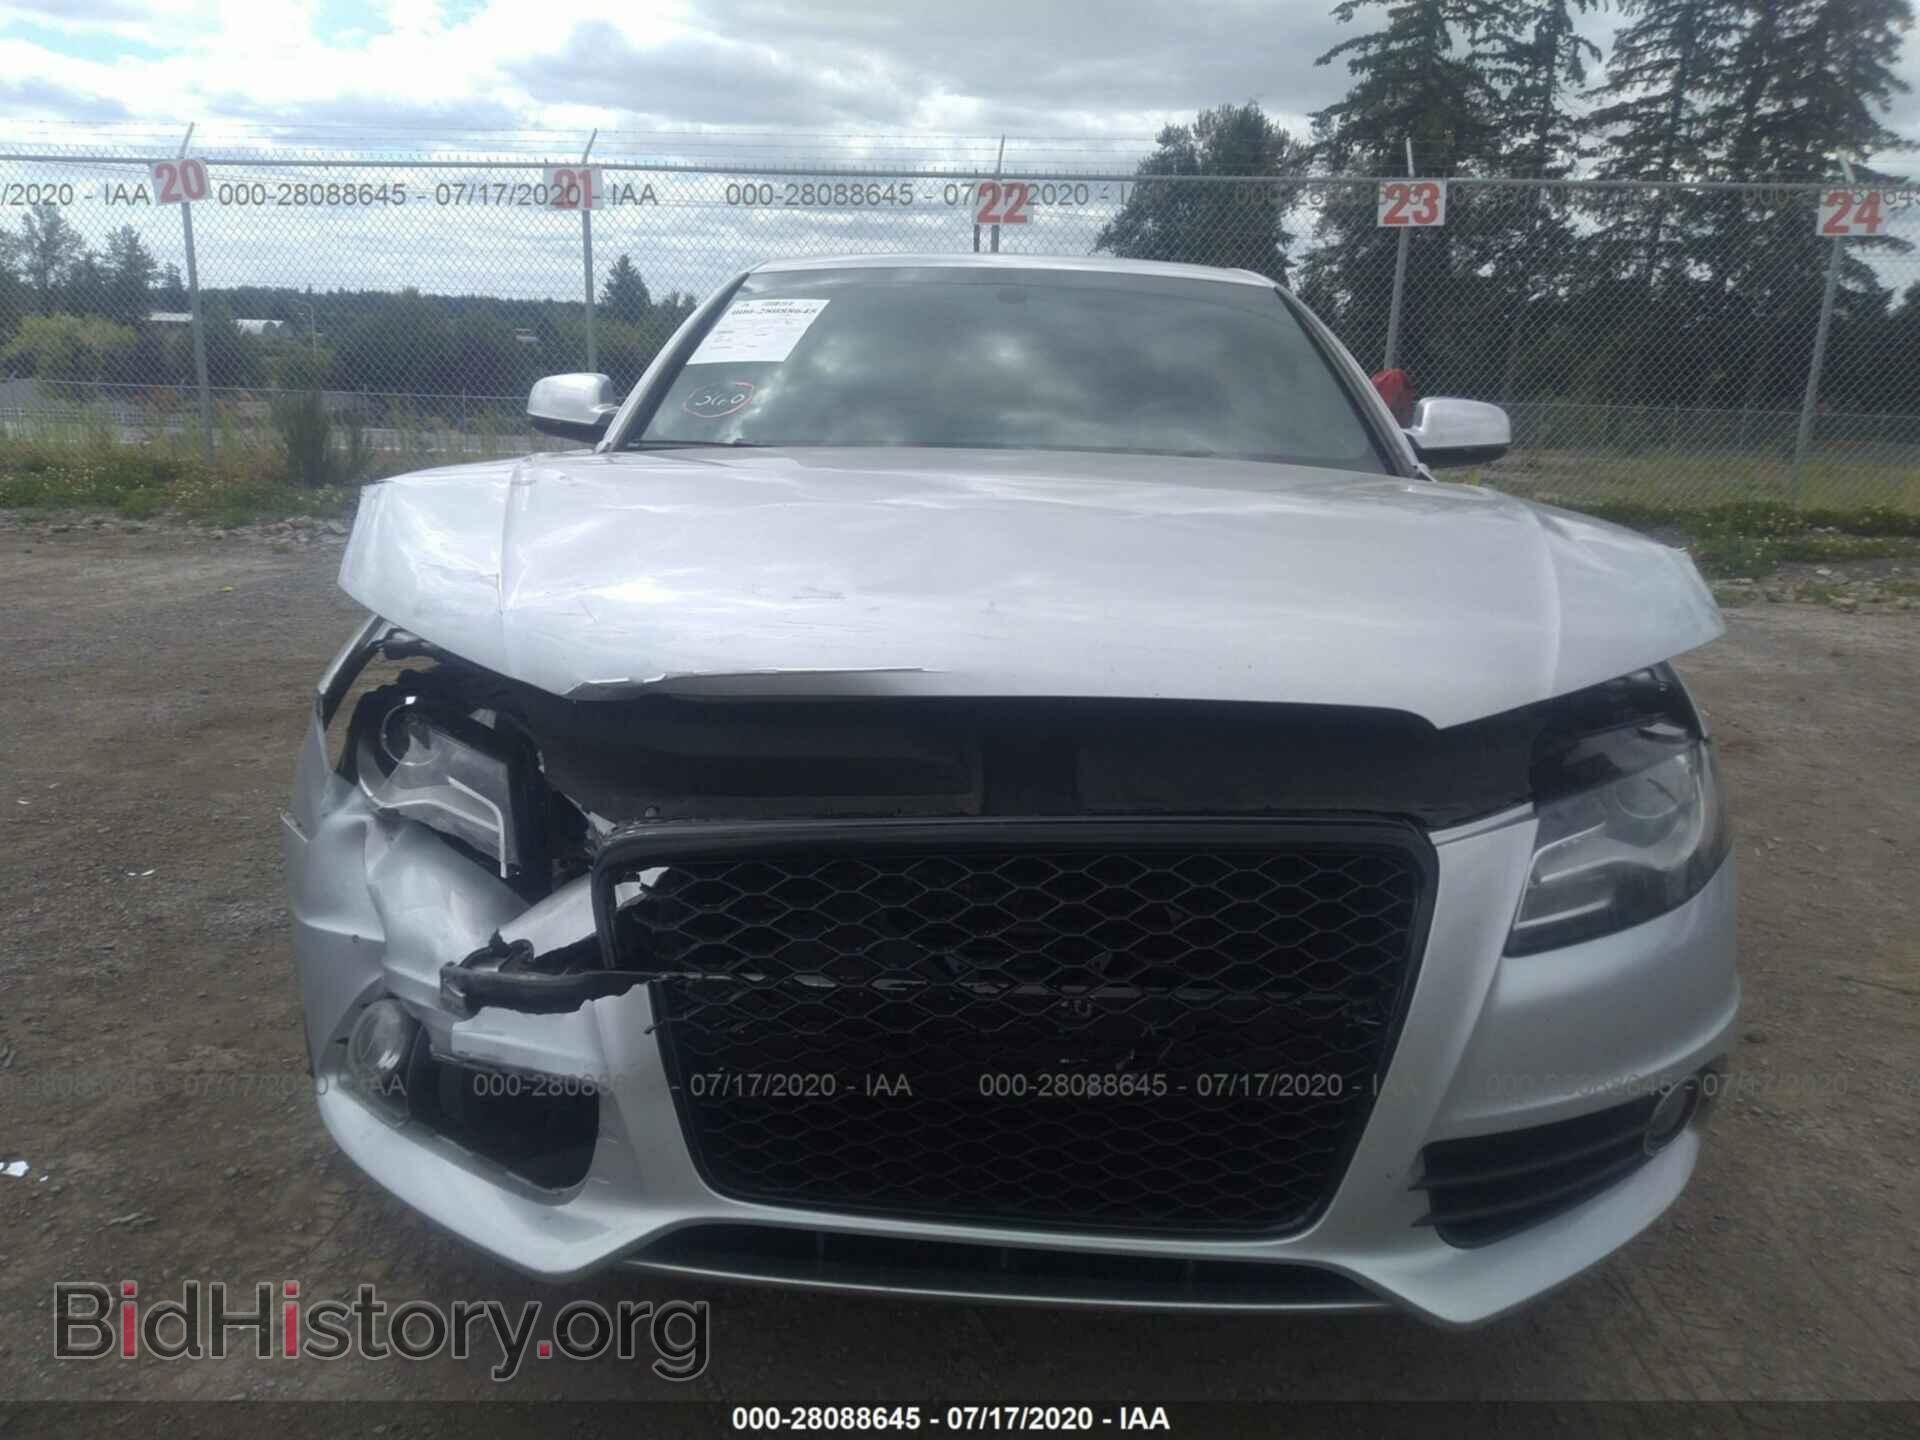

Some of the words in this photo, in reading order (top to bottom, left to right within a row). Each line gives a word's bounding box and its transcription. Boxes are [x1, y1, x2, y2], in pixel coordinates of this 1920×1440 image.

[156, 159, 207, 203] 20
[976, 180, 1028, 224] 22
[1384, 181, 1441, 225] 23
[1822, 191, 1883, 234] 24
